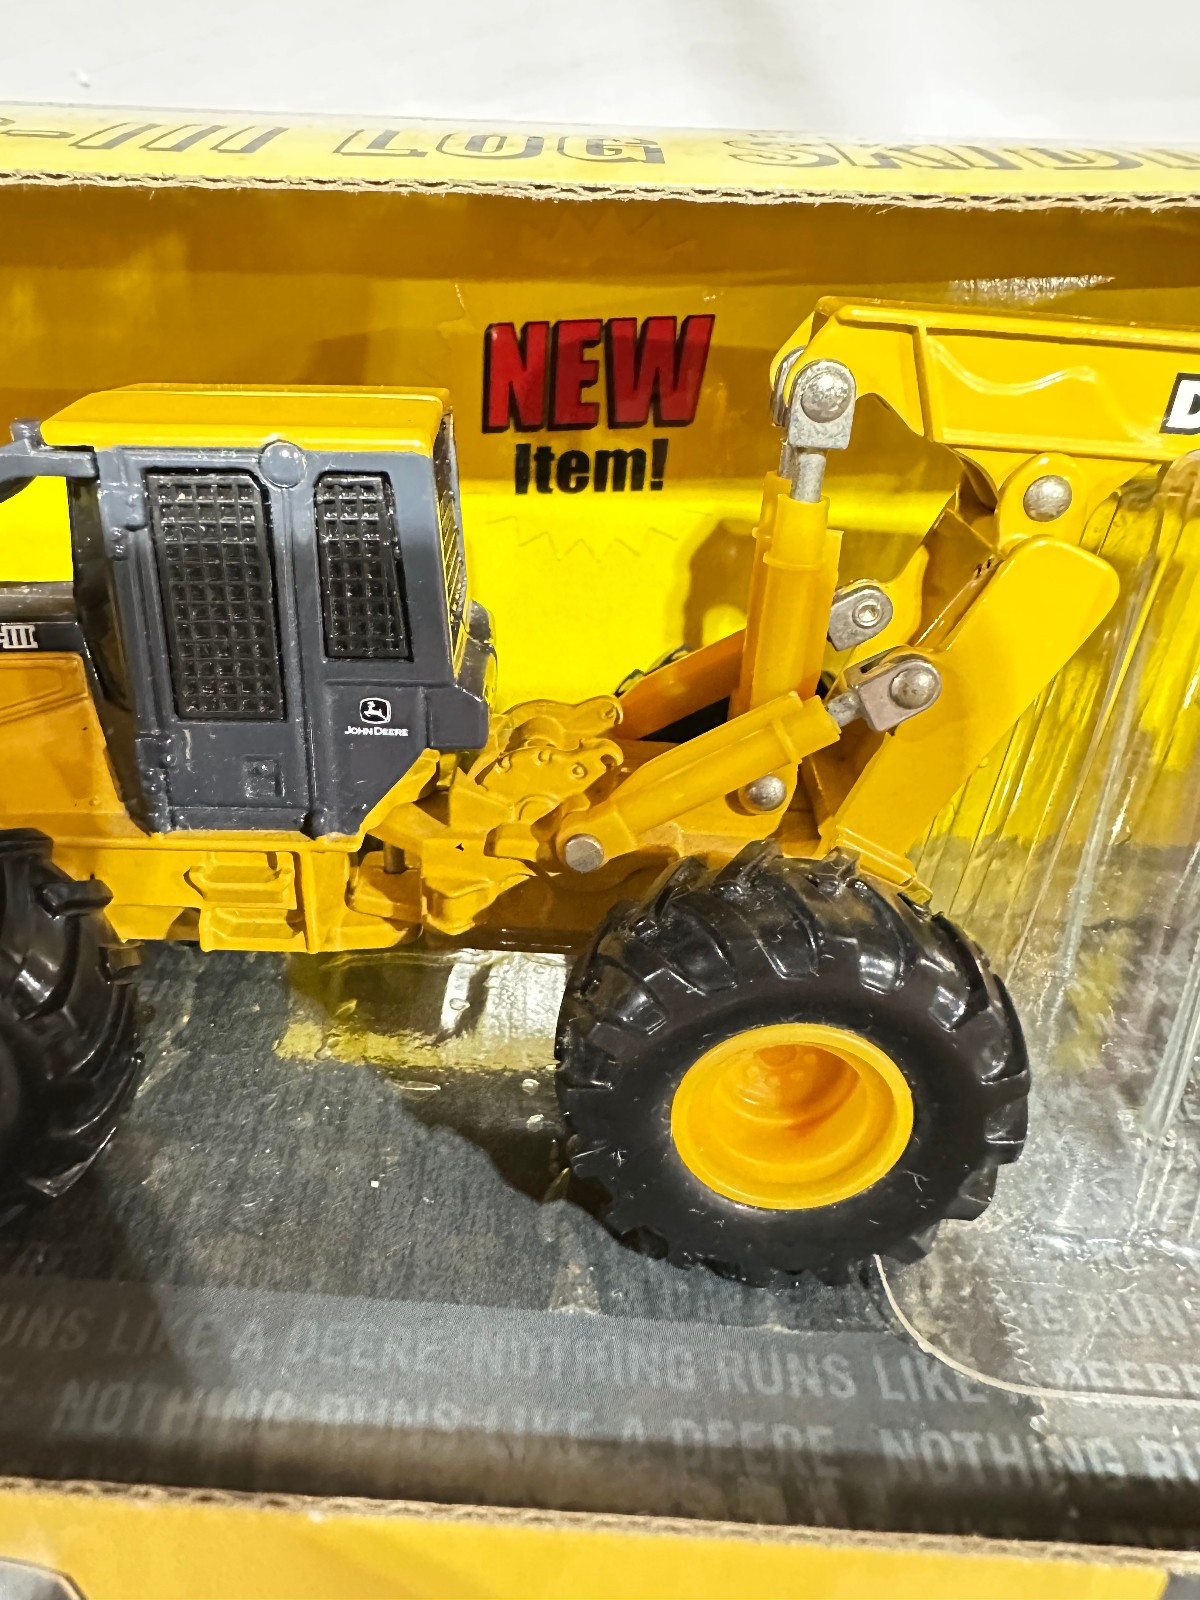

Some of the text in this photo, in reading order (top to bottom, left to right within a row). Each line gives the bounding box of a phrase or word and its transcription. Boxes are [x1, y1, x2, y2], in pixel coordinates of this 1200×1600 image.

[332, 128, 666, 165] LOG
[482, 313, 716, 434] NEW
[514, 438, 669, 495] Item!
[344, 725, 409, 737] JOHN DEERE
[717, 1349, 858, 1399] RUNS
